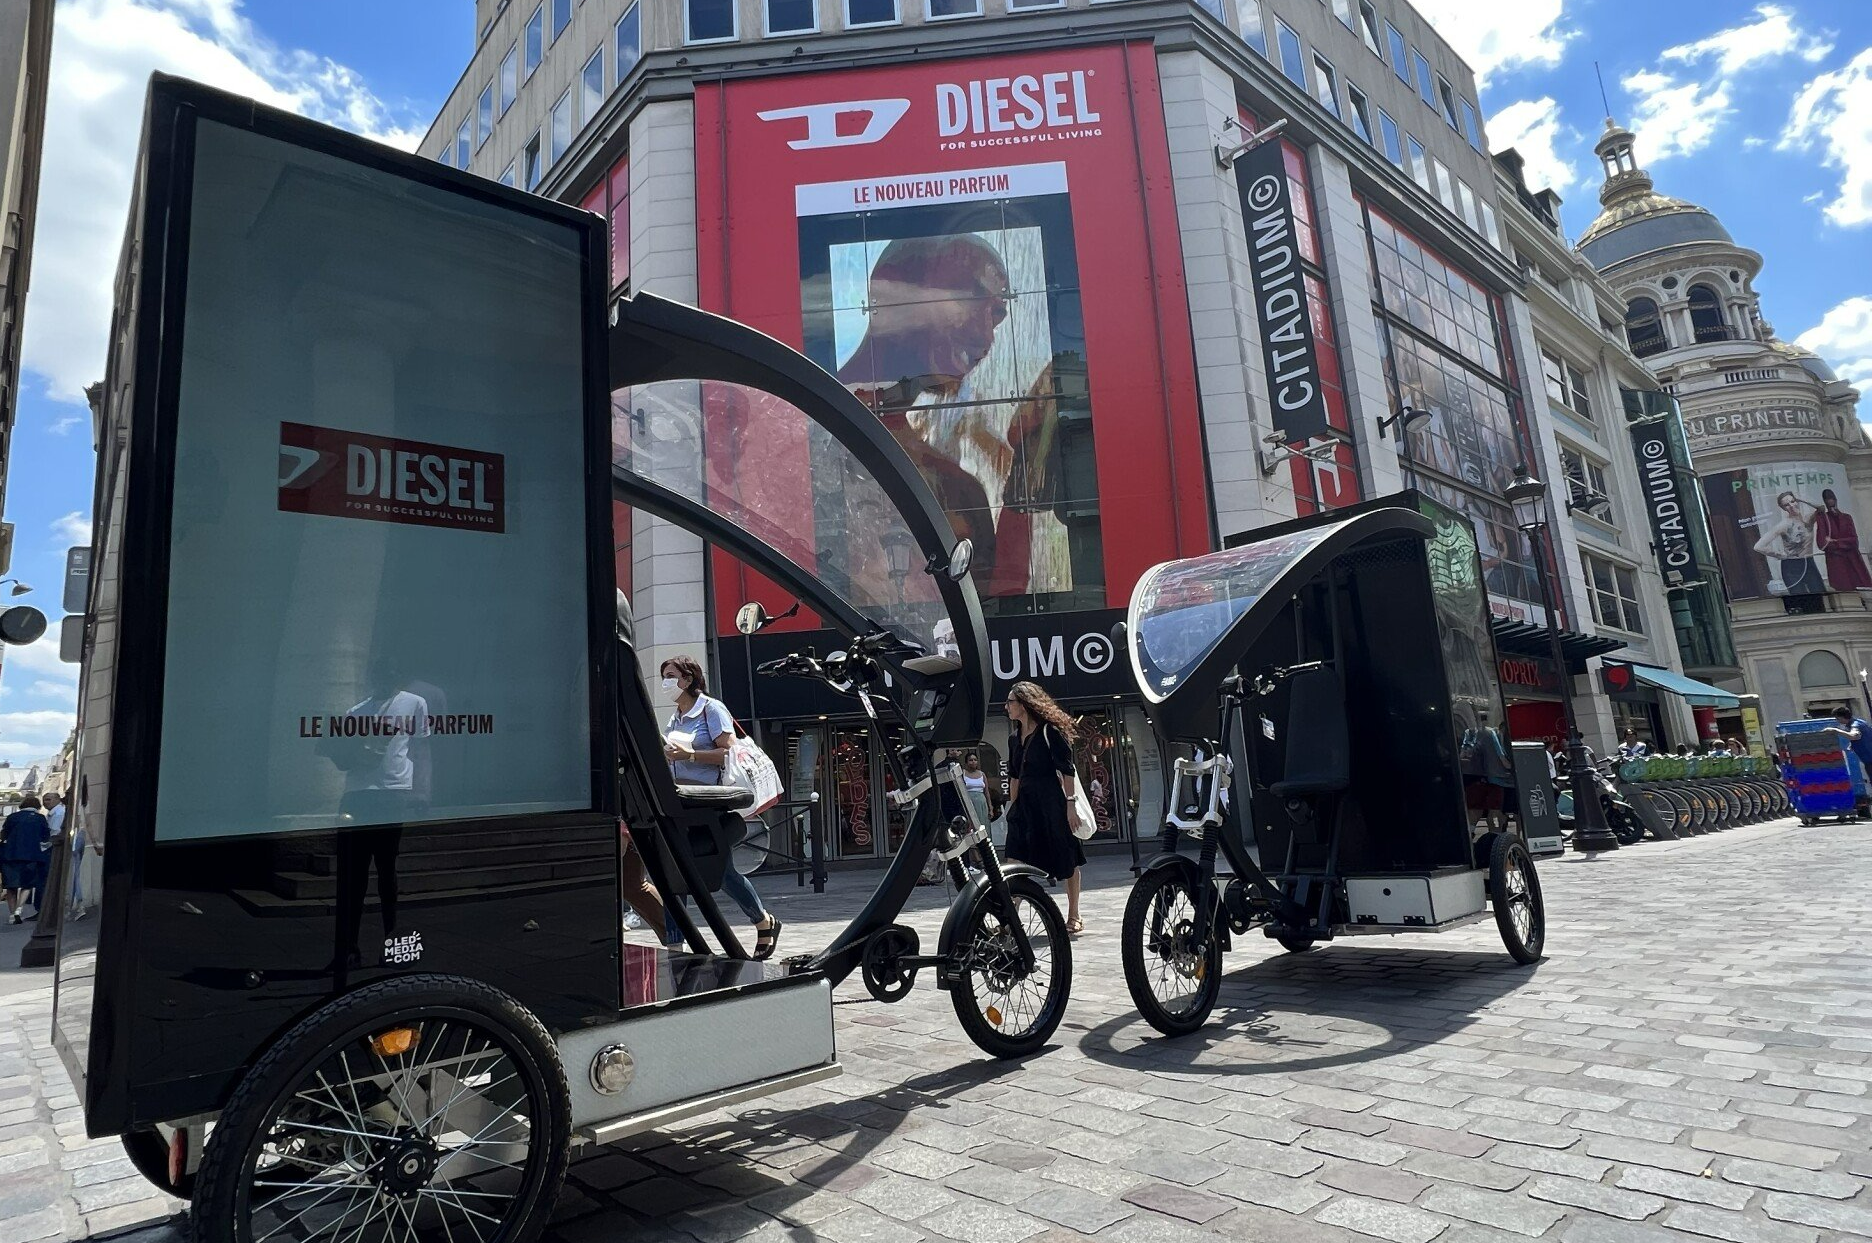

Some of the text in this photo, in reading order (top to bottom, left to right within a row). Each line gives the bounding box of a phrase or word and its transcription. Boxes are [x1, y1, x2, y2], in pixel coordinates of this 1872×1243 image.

[940, 128, 1102, 151] FOR SUCCESSFUL LIVING
[854, 174, 1010, 204] LE NOUVEAU PARFUM
[346, 443, 495, 512] DIESEL
[1731, 473, 1834, 493] PRINTEMPS
[346, 501, 494, 524] FOR SUCCESSFUL LIVING
[300, 714, 494, 738] LE NOUVEAU PARFUM
[385, 943, 423, 957] MEDIA
[394, 936, 417, 946] LED
